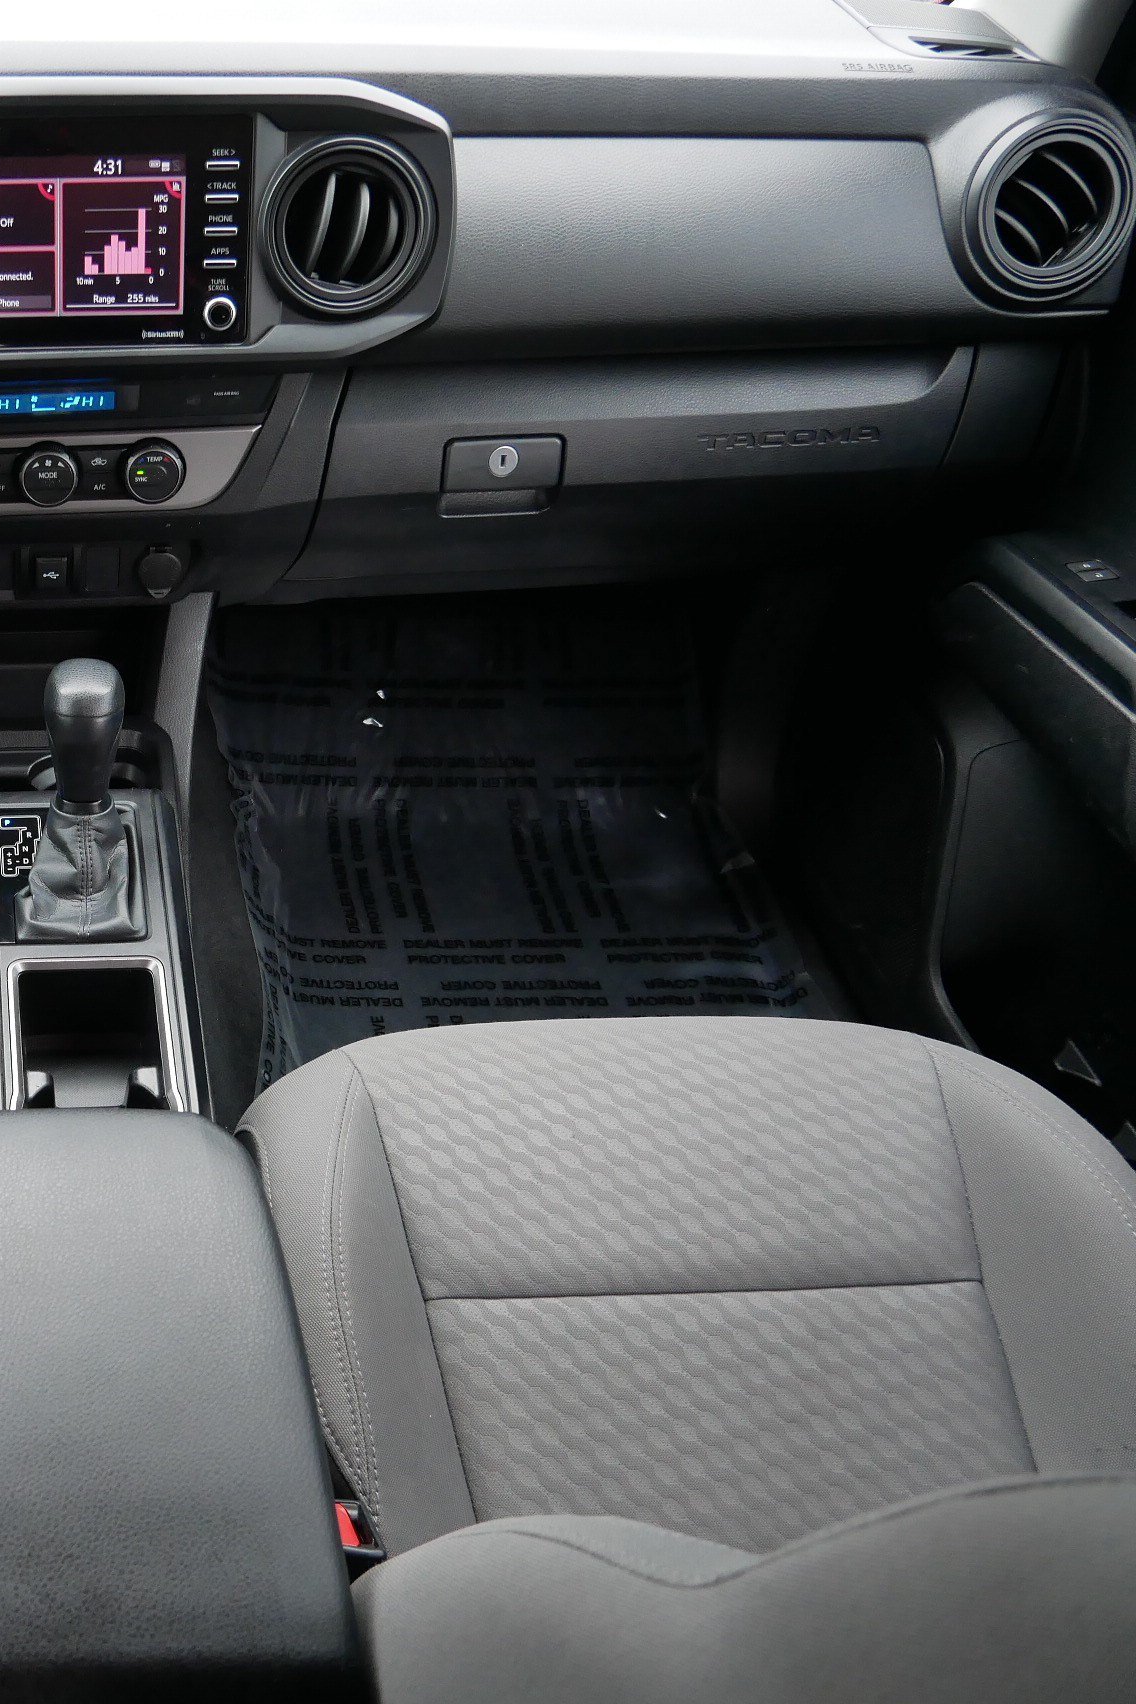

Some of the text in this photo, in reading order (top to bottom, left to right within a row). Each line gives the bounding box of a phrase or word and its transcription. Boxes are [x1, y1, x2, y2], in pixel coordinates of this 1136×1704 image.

[868, 63, 914, 73] AIRBAG
[212, 149, 229, 157] SEEK
[93, 159, 122, 175] 4:31
[213, 181, 237, 189] TRACK
[153, 194, 168, 203] MPG
[158, 205, 167, 213] 30
[0, 217, 14, 228] Off
[208, 215, 233, 223] PHONE
[158, 226, 167, 234] 20
[158, 247, 166, 255] 10
[210, 247, 230, 255] APPS
[159, 268, 164, 276] 0
[115, 276, 121, 284] 5
[148, 276, 154, 284] 0
[93, 294, 116, 305] Range
[127, 294, 144, 303] 255
[697, 426, 880, 451] TACOMA
[321, 939, 387, 950] REMOVE
[403, 938, 465, 949] DEALER
[469, 938, 513, 949] MUST
[313, 954, 367, 965] COVER
[407, 953, 566, 965] PROTECTIVE COVER
[299, 977, 400, 991] PROTECTIVE
[441, 979, 602, 991] PROTECTIVE COVER
[292, 992, 404, 1007] DEALER MUST
[420, 996, 609, 1007] DEALER MUST REMOVE
